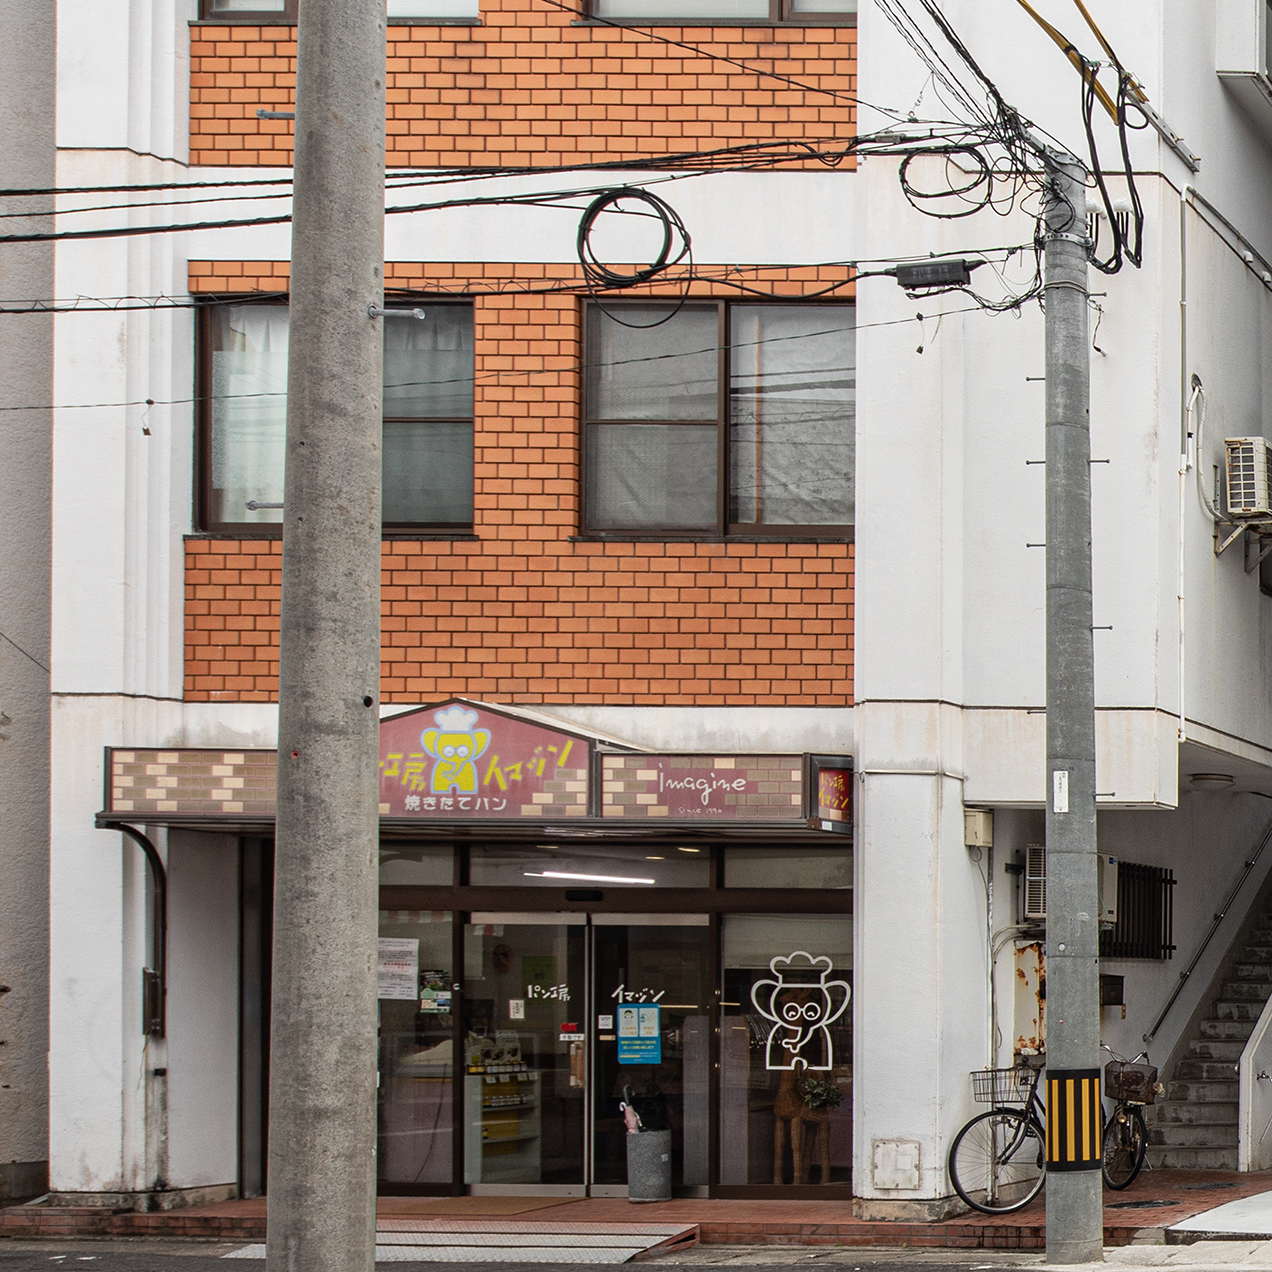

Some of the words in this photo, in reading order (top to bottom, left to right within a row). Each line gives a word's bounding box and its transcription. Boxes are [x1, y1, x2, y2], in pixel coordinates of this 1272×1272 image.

[404, 795, 507, 812] 焼きたてパン
[527, 983, 571, 1002] パン工房
